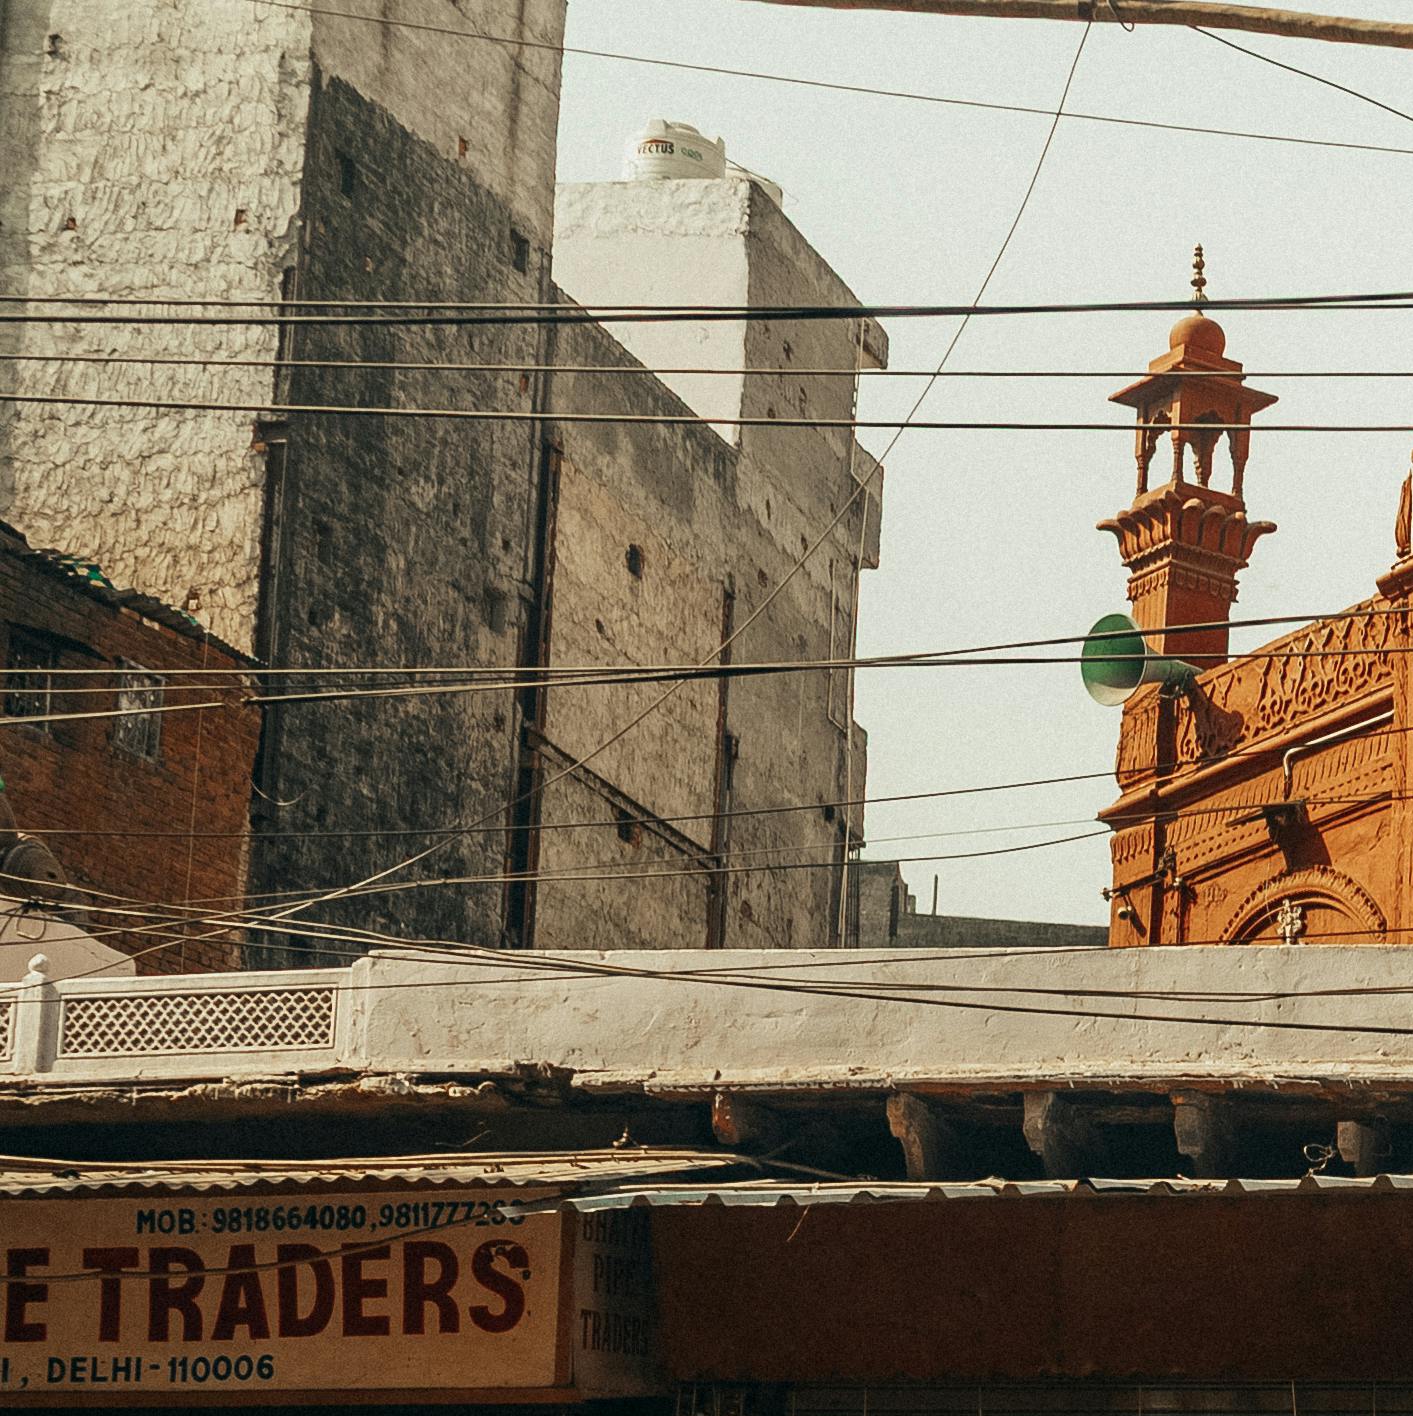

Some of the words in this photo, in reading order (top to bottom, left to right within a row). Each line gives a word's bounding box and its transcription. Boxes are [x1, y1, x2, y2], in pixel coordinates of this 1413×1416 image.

[637, 142, 675, 155] VECTUS
[83, 1240, 533, 1343] TRADERS
[47, 1355, 275, 1384] DELHI-110006
